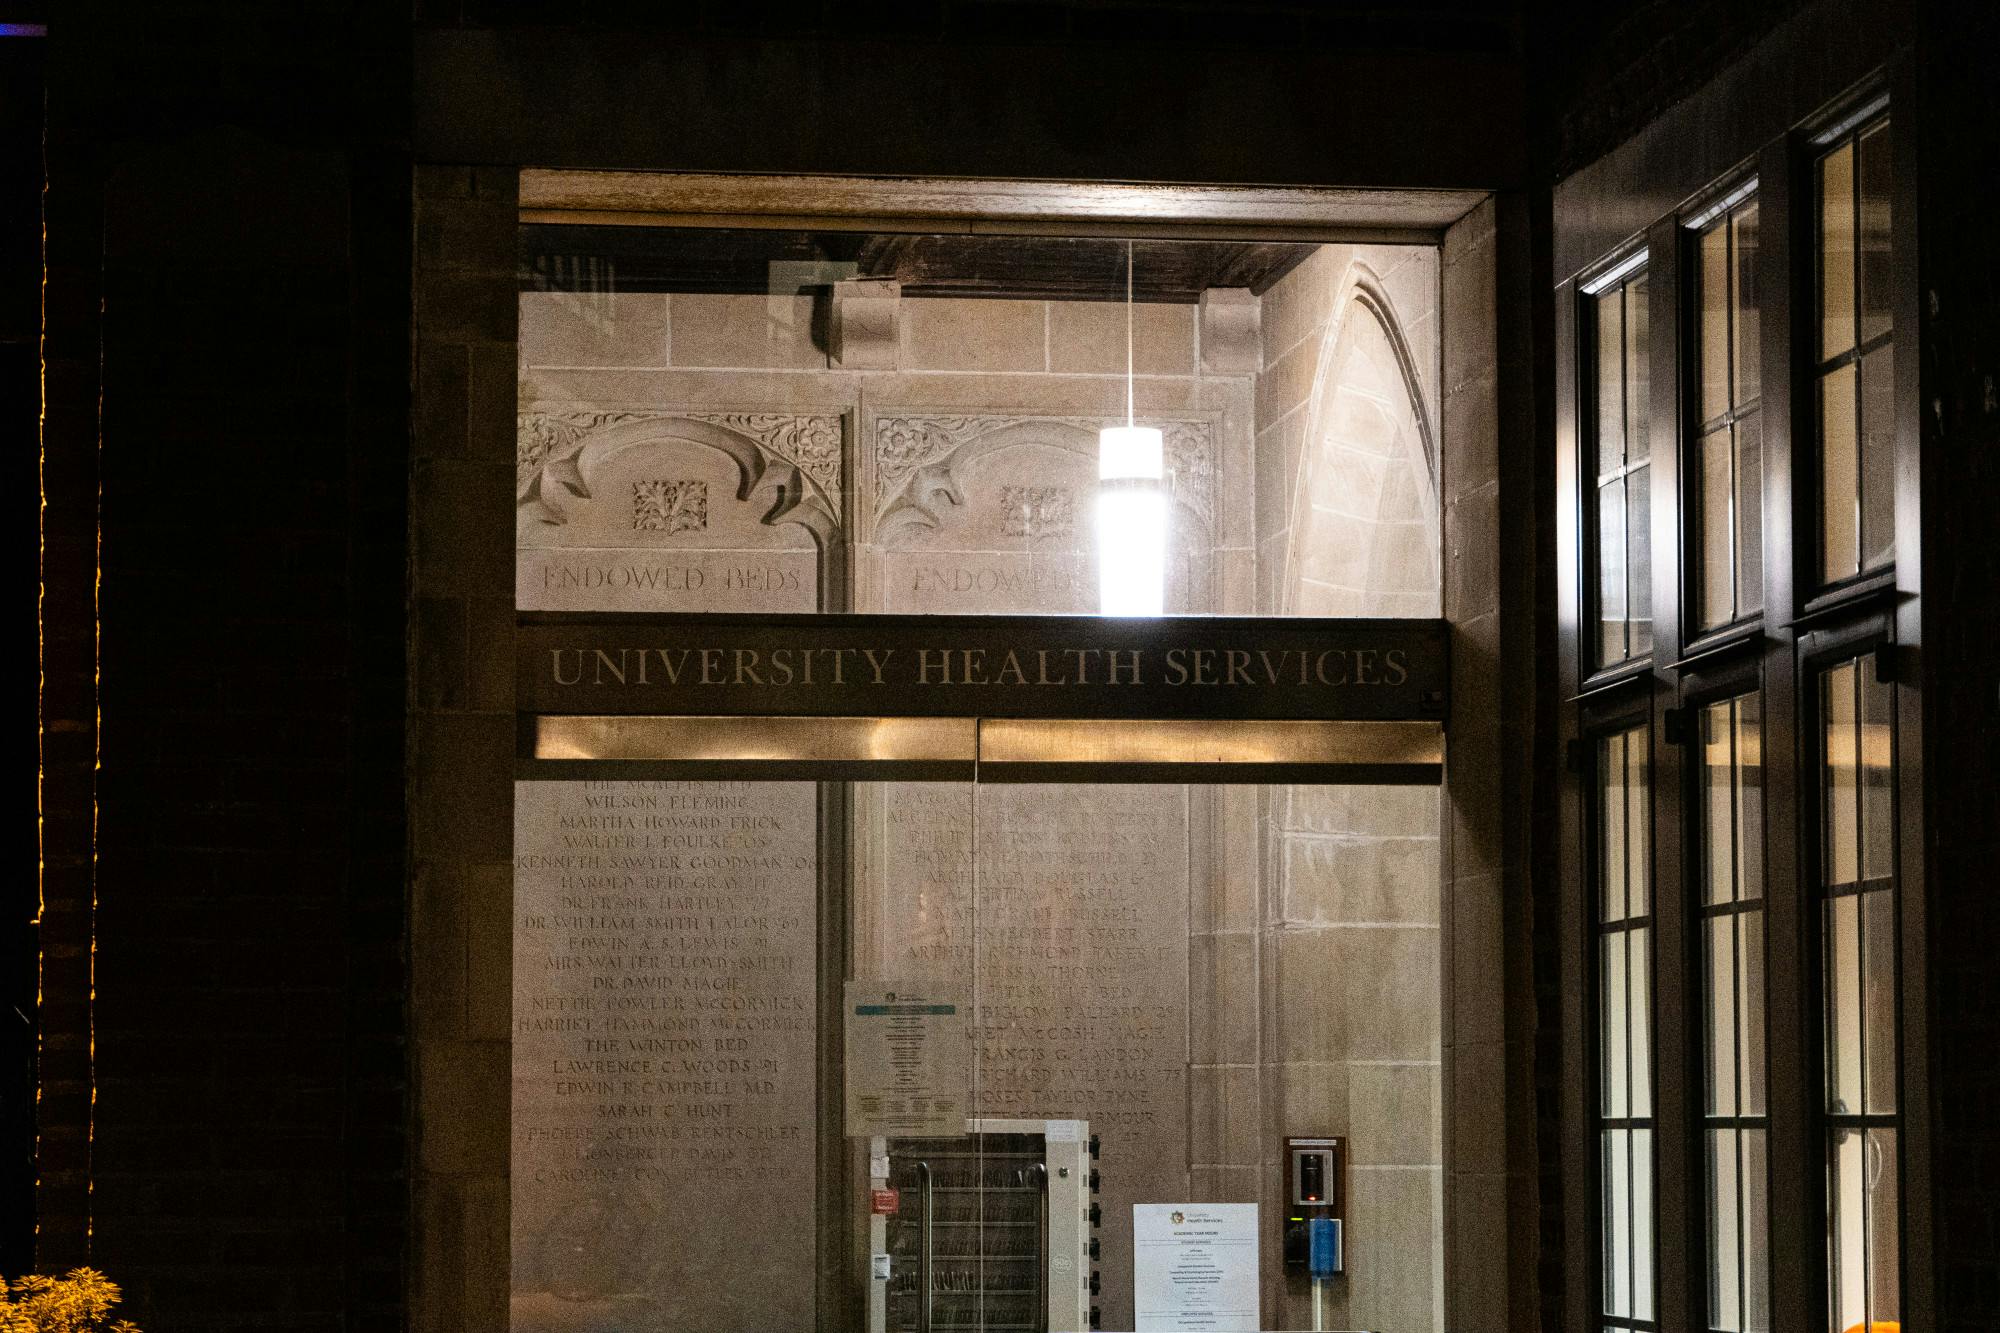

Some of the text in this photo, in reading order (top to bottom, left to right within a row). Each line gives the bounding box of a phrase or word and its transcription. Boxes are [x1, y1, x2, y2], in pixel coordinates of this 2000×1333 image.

[543, 566, 800, 590] ENDOWED BEDS
[911, 567, 1072, 592] ENDOWED
[553, 649, 1408, 686] UNIVERSITY HEALTH SERVICES
[584, 795, 748, 809] WILSON FLEMING
[559, 815, 782, 830] MARTHA HOWARD FRICK
[563, 835, 635, 849] WALTER
[516, 855, 599, 869] KENNETH
[609, 855, 681, 869] SAWYER
[689, 855, 782, 869] GOODMAN
[561, 876, 635, 890] HAROLD
[644, 876, 685, 890] REID
[692, 876, 739, 890] GRAY
[590, 896, 649, 910] FRANK
[553, 916, 635, 930] WILLIAM
[644, 916, 700, 930] SMITH
[568, 937, 629, 951] EDWIN
[680, 937, 739, 951] LEWIS
[587, 955, 660, 970] WALTER
[622, 976, 674, 990] DAVID
[682, 976, 743, 990] MAGIE
[531, 996, 594, 1011] NETTIE
[606, 996, 686, 1011] FOWLER
[517, 1017, 594, 1031] HARRIET
[606, 1017, 702, 1031] HAMMOND
[584, 1038, 749, 1053] THE WINTON BED
[552, 1059, 652, 1074] LAWRENCE
[681, 1059, 752, 1074] WOODS
[555, 1080, 615, 1096] EDWIN
[641, 1080, 734, 1096] CAMPBELL
[596, 1104, 653, 1119] SARAH
[686, 1104, 733, 1119] HUNT
[526, 1126, 801, 1141] PHOEBE SCHWAB RENTSCHLER
